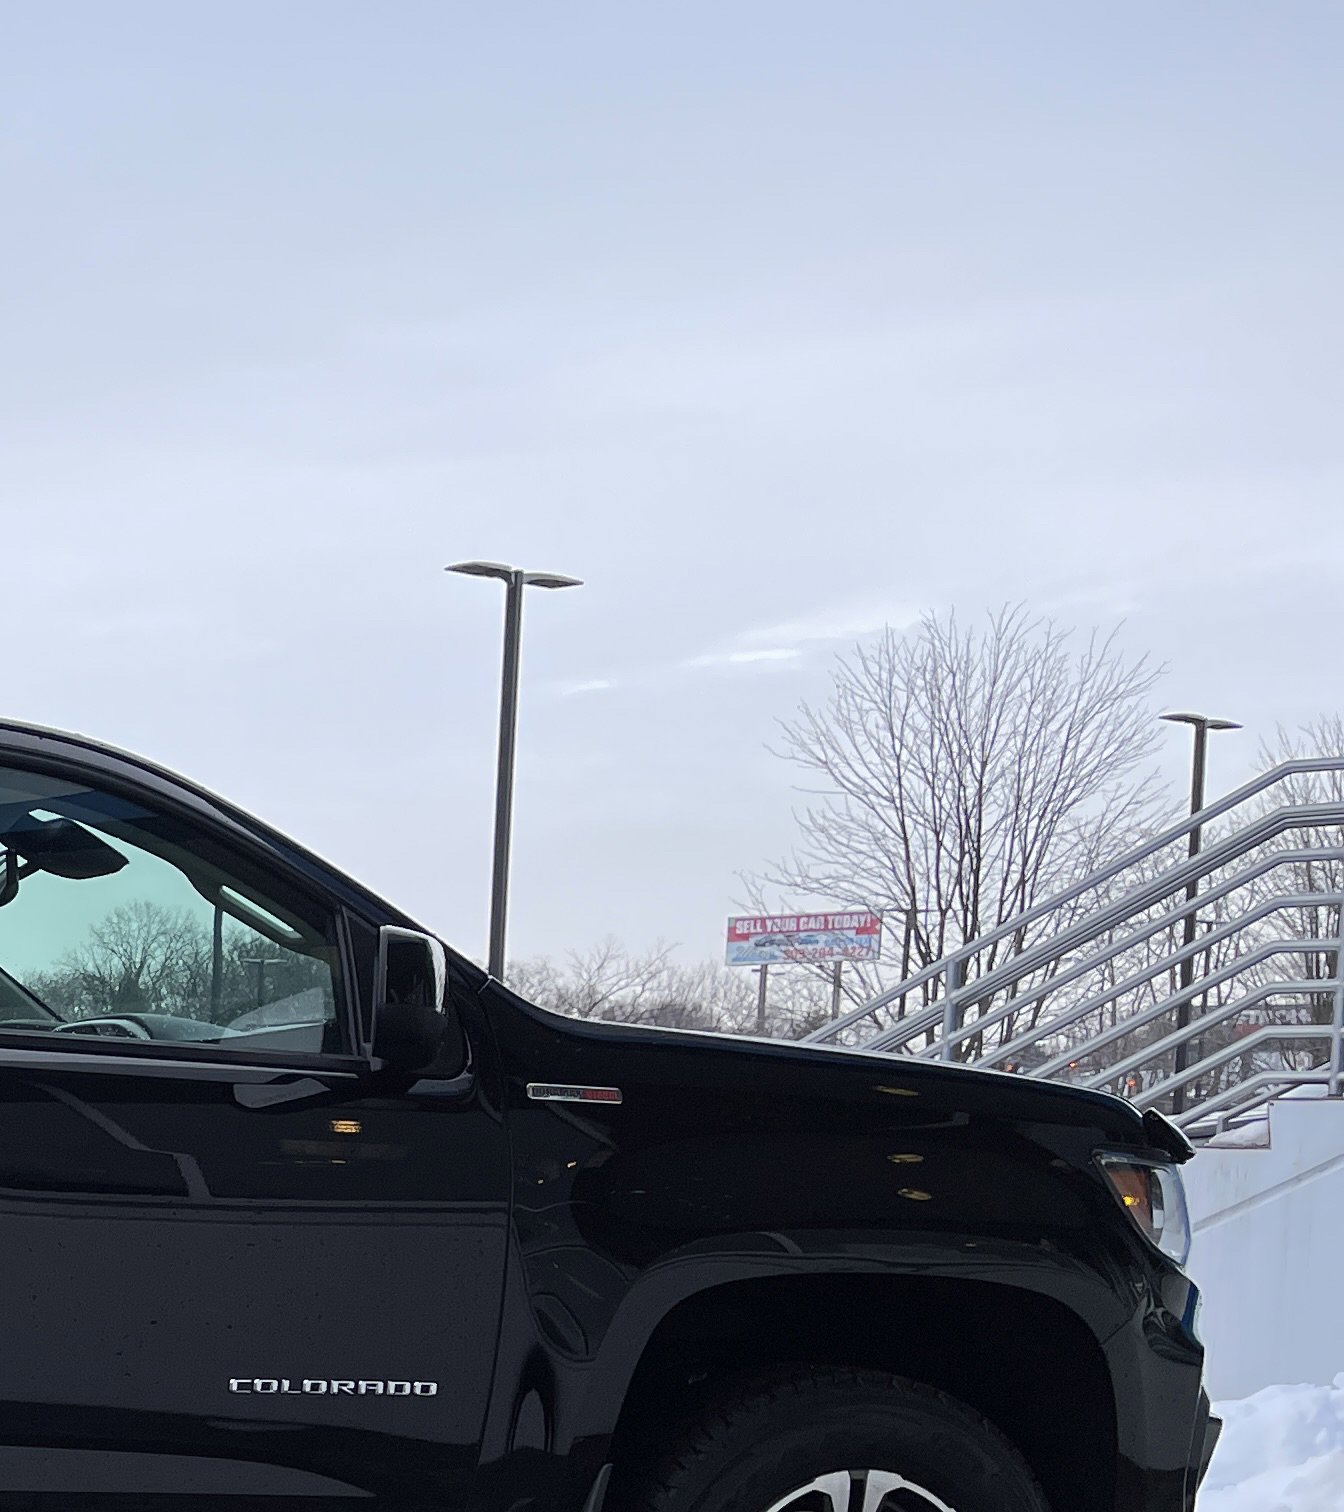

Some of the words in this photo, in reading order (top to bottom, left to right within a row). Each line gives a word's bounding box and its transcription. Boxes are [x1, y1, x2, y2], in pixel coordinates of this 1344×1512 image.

[735, 918, 763, 934] SELL
[765, 917, 797, 932] YOUR
[799, 916, 824, 930] CAR
[828, 914, 871, 929] TODAY!
[229, 1378, 438, 1396] COLORADO
